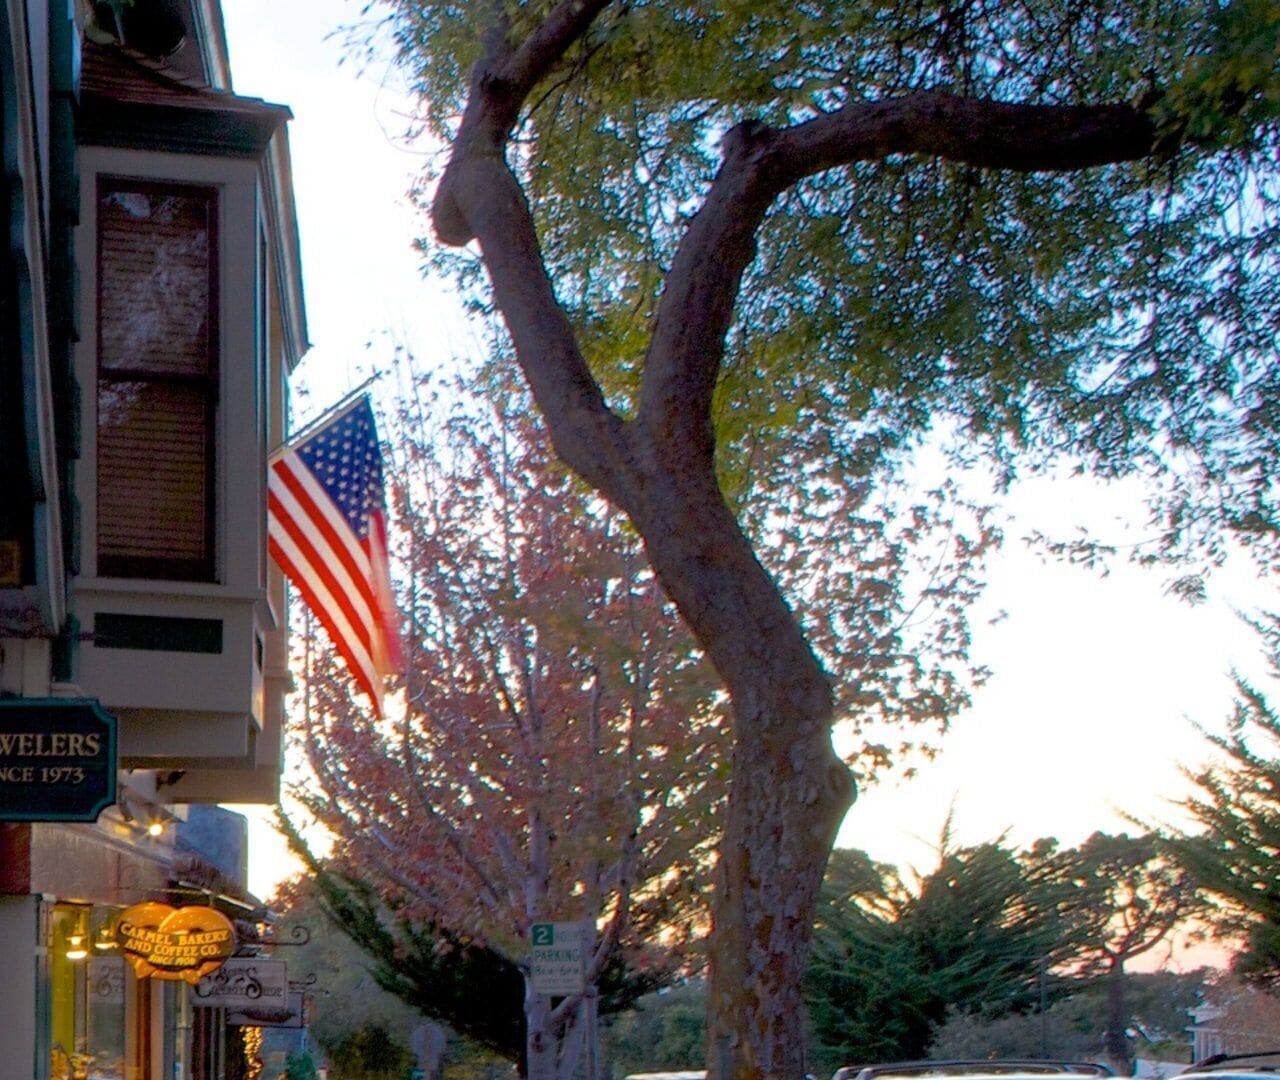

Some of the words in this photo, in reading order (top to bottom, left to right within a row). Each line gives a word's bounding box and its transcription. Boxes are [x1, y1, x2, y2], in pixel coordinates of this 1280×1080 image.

[41, 766, 86, 785] 1973
[120, 923, 173, 946] CARMEL
[178, 929, 230, 946] BAKERY
[536, 926, 550, 944] 2
[125, 938, 152, 953] AND
[154, 944, 199, 957] COFFEE
[200, 945, 222, 956] CO.
[534, 949, 579, 961] PARKING
